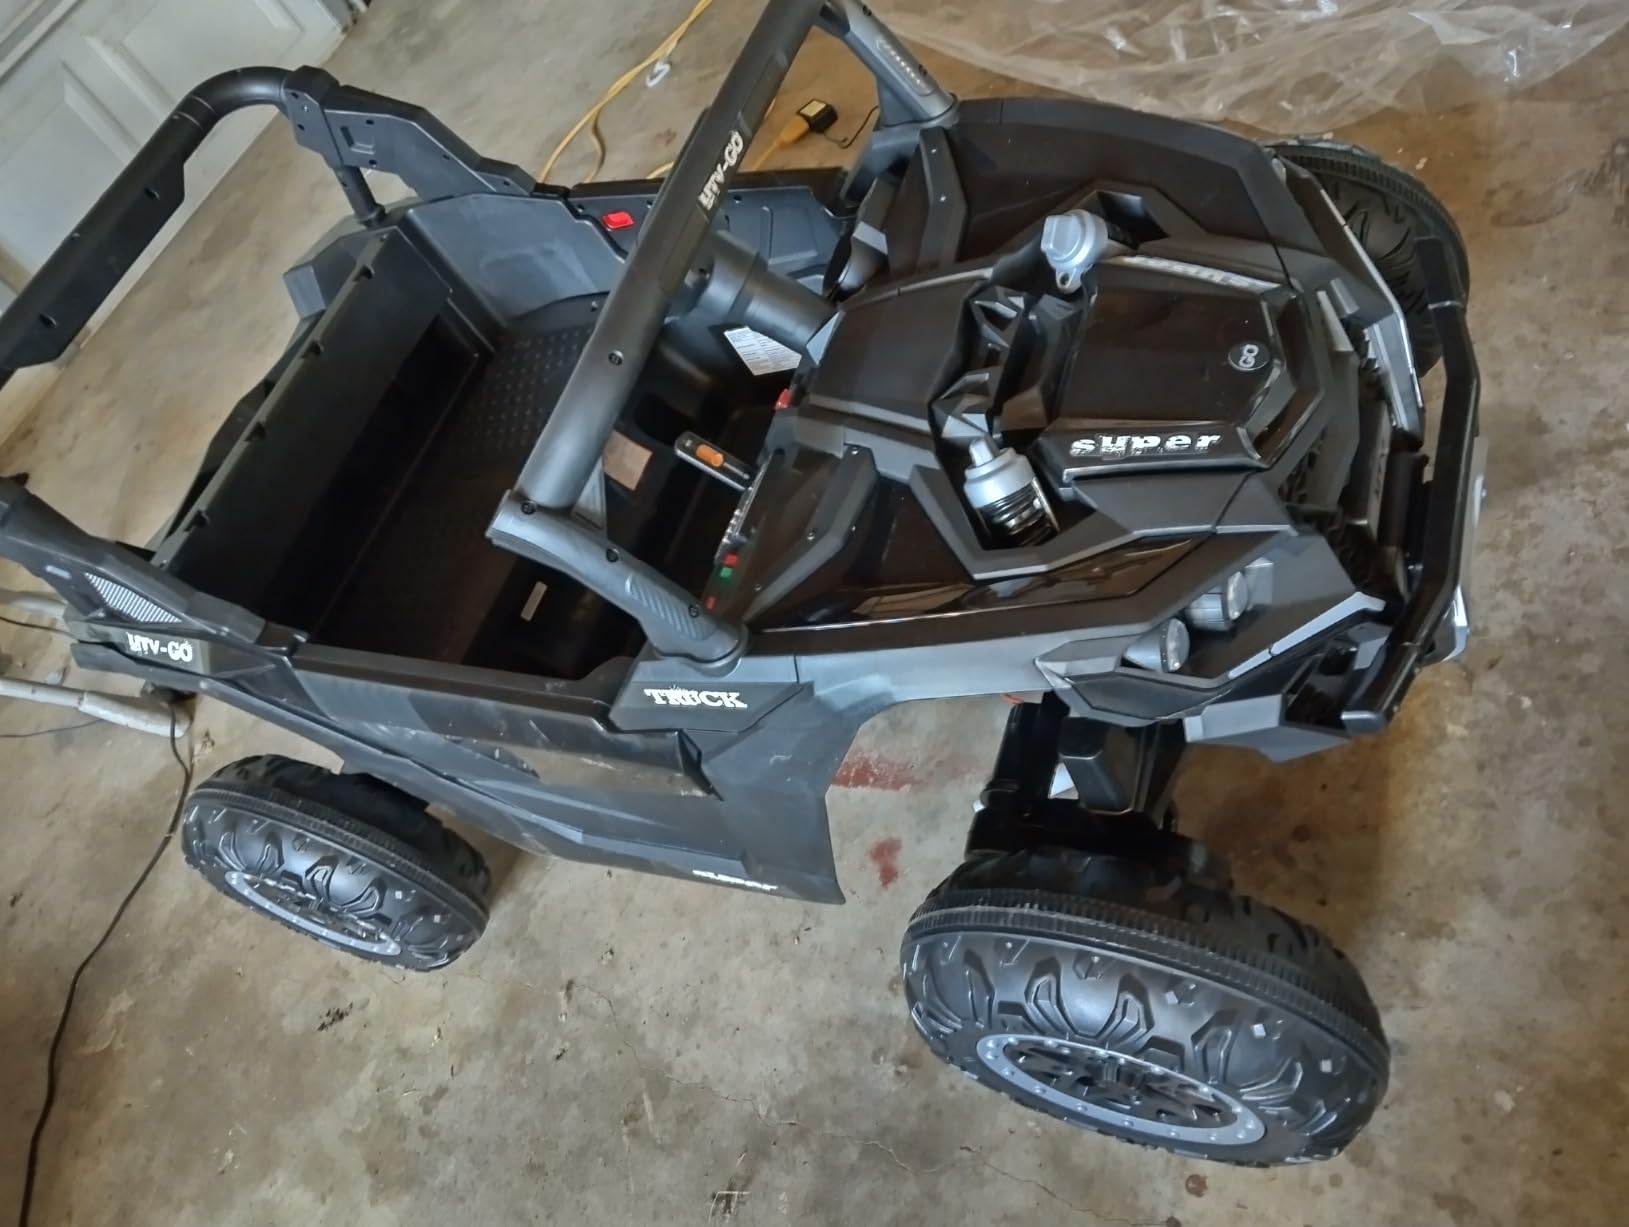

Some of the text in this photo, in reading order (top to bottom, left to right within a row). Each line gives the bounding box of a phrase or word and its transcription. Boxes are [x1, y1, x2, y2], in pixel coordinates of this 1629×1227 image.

[1238, 343, 1260, 368] GO
[1069, 433, 1222, 457] super
[125, 631, 193, 662] UTV-GO
[643, 685, 748, 708] TRUCK
